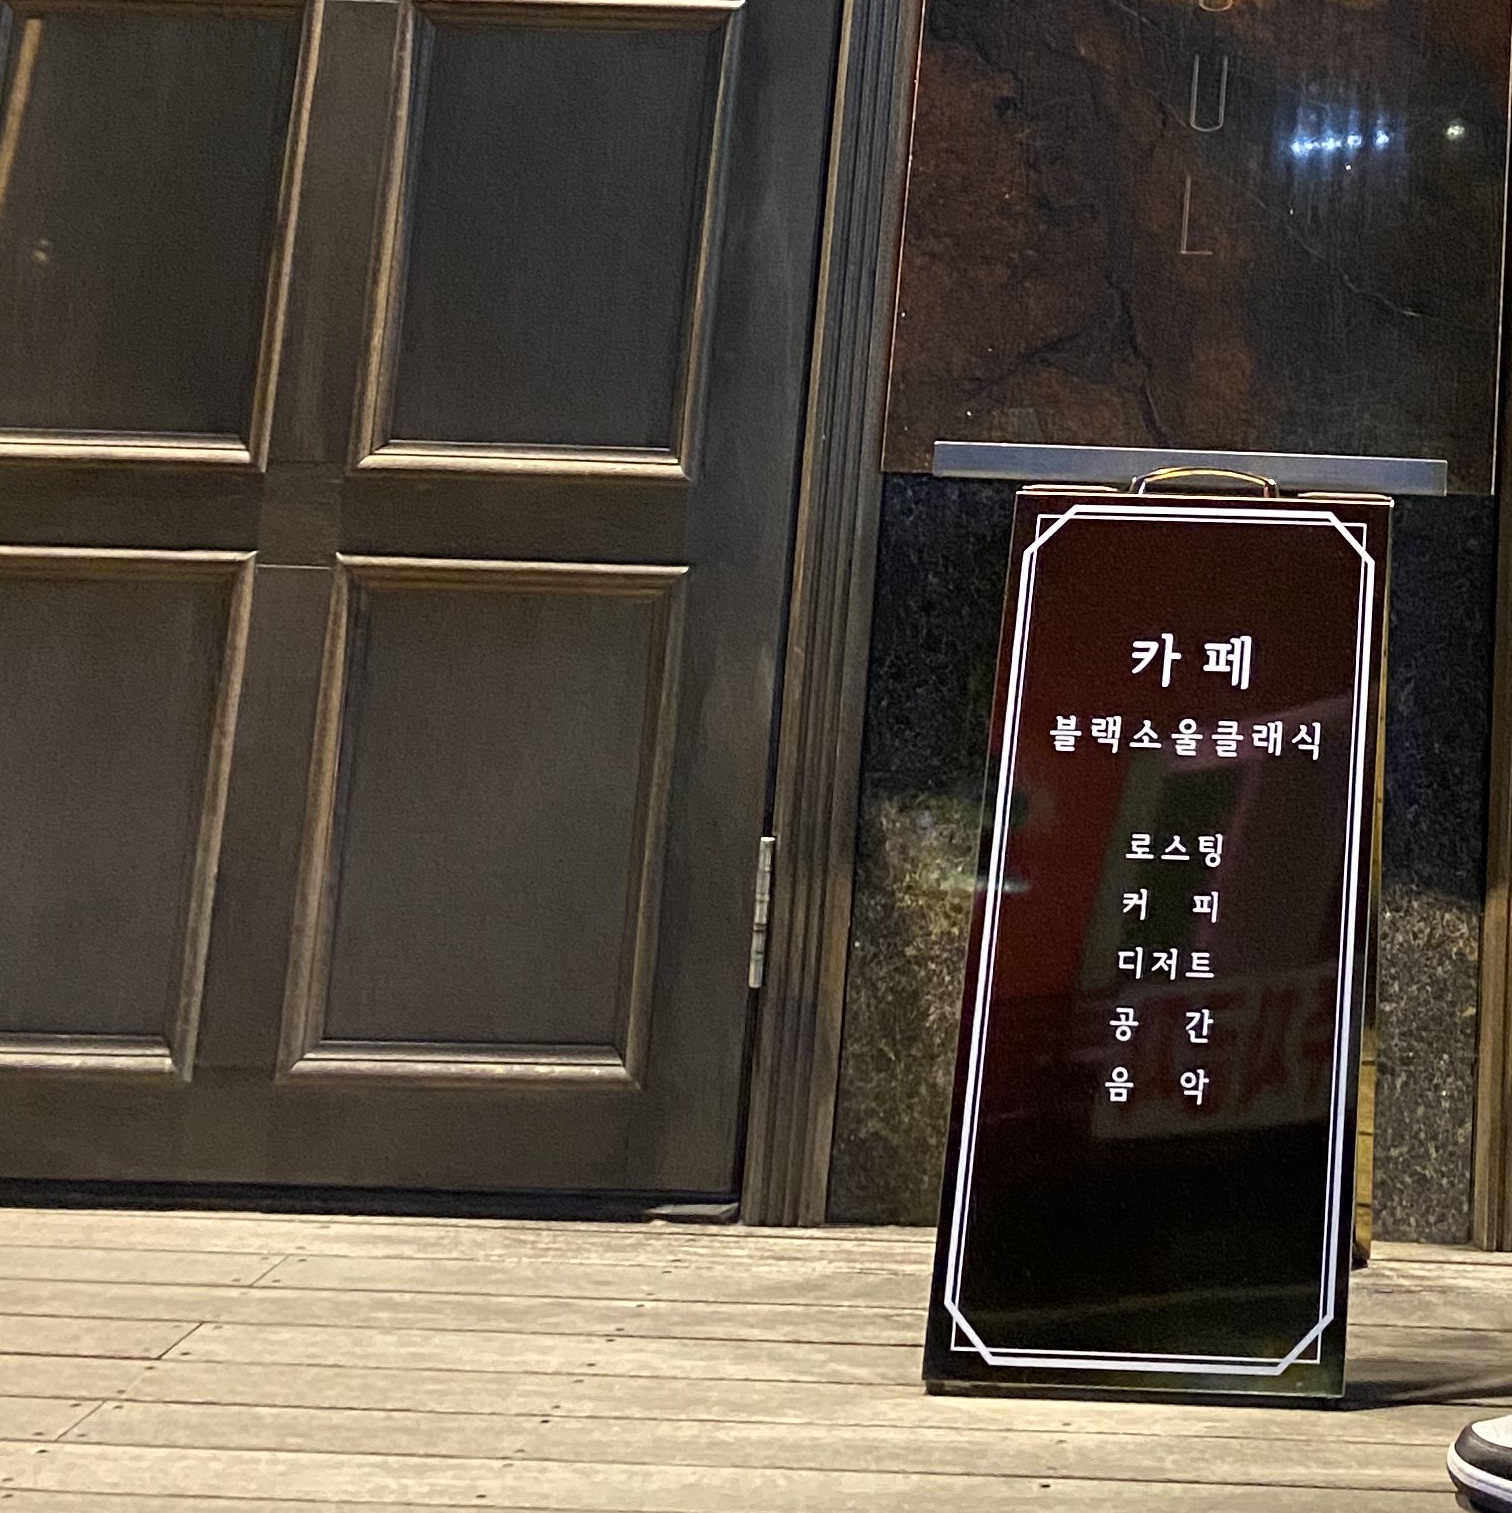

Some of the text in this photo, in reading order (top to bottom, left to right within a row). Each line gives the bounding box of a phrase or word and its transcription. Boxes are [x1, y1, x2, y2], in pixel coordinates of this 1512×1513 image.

[1049, 714, 1322, 761] 블랙소울클래식
[1125, 833, 1224, 868] 로스팅
[1117, 946, 1215, 981] 디저트
